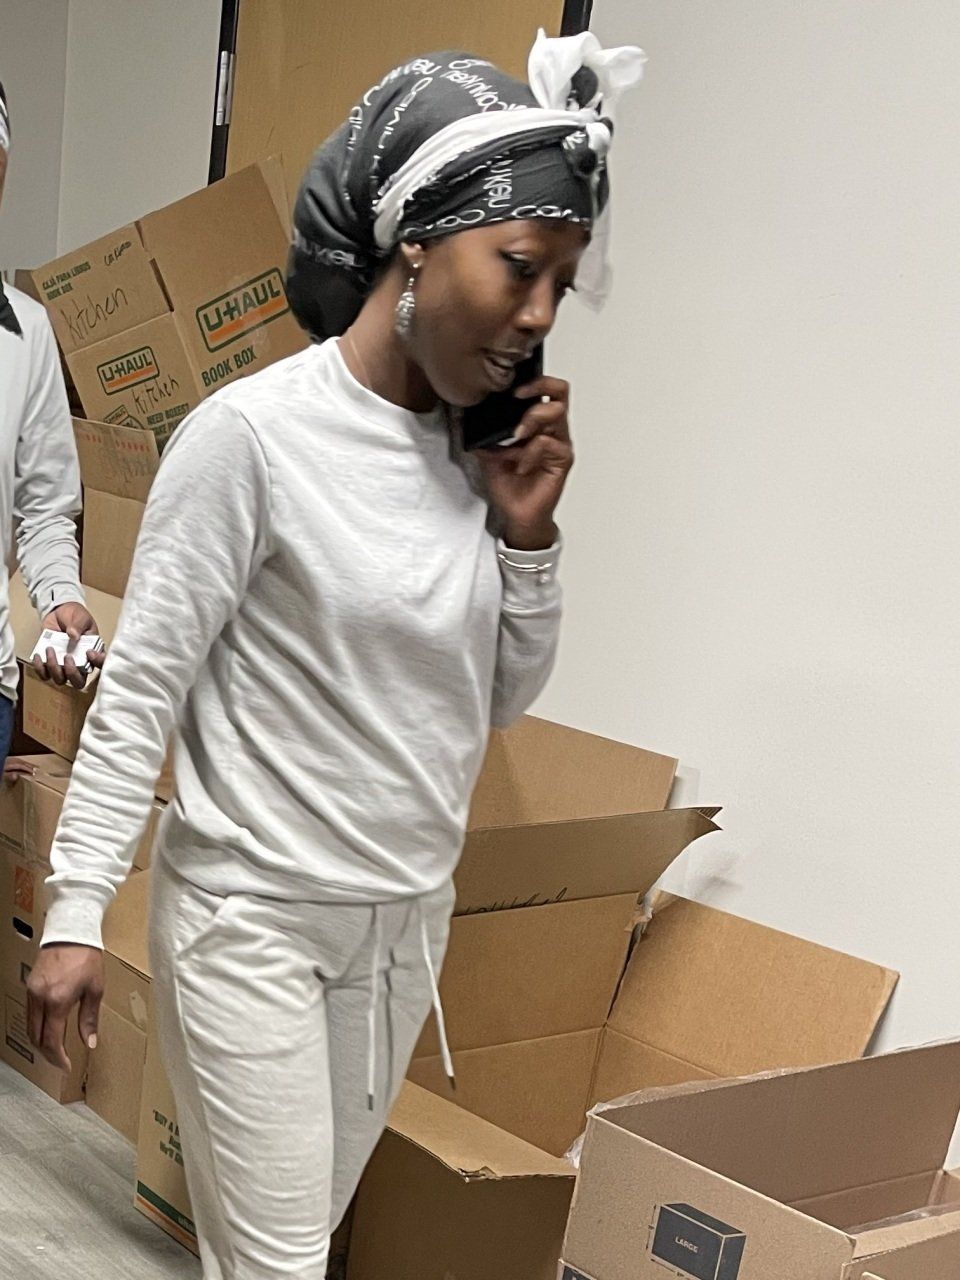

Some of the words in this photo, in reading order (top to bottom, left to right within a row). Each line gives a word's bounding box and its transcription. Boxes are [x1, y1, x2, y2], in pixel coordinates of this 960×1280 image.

[203, 278, 281, 332] U-HAUL
[101, 352, 153, 383] U-HAUL
[201, 358, 234, 388] BOOK
[233, 345, 259, 370] BOX
[675, 1236, 699, 1254] LARGE
